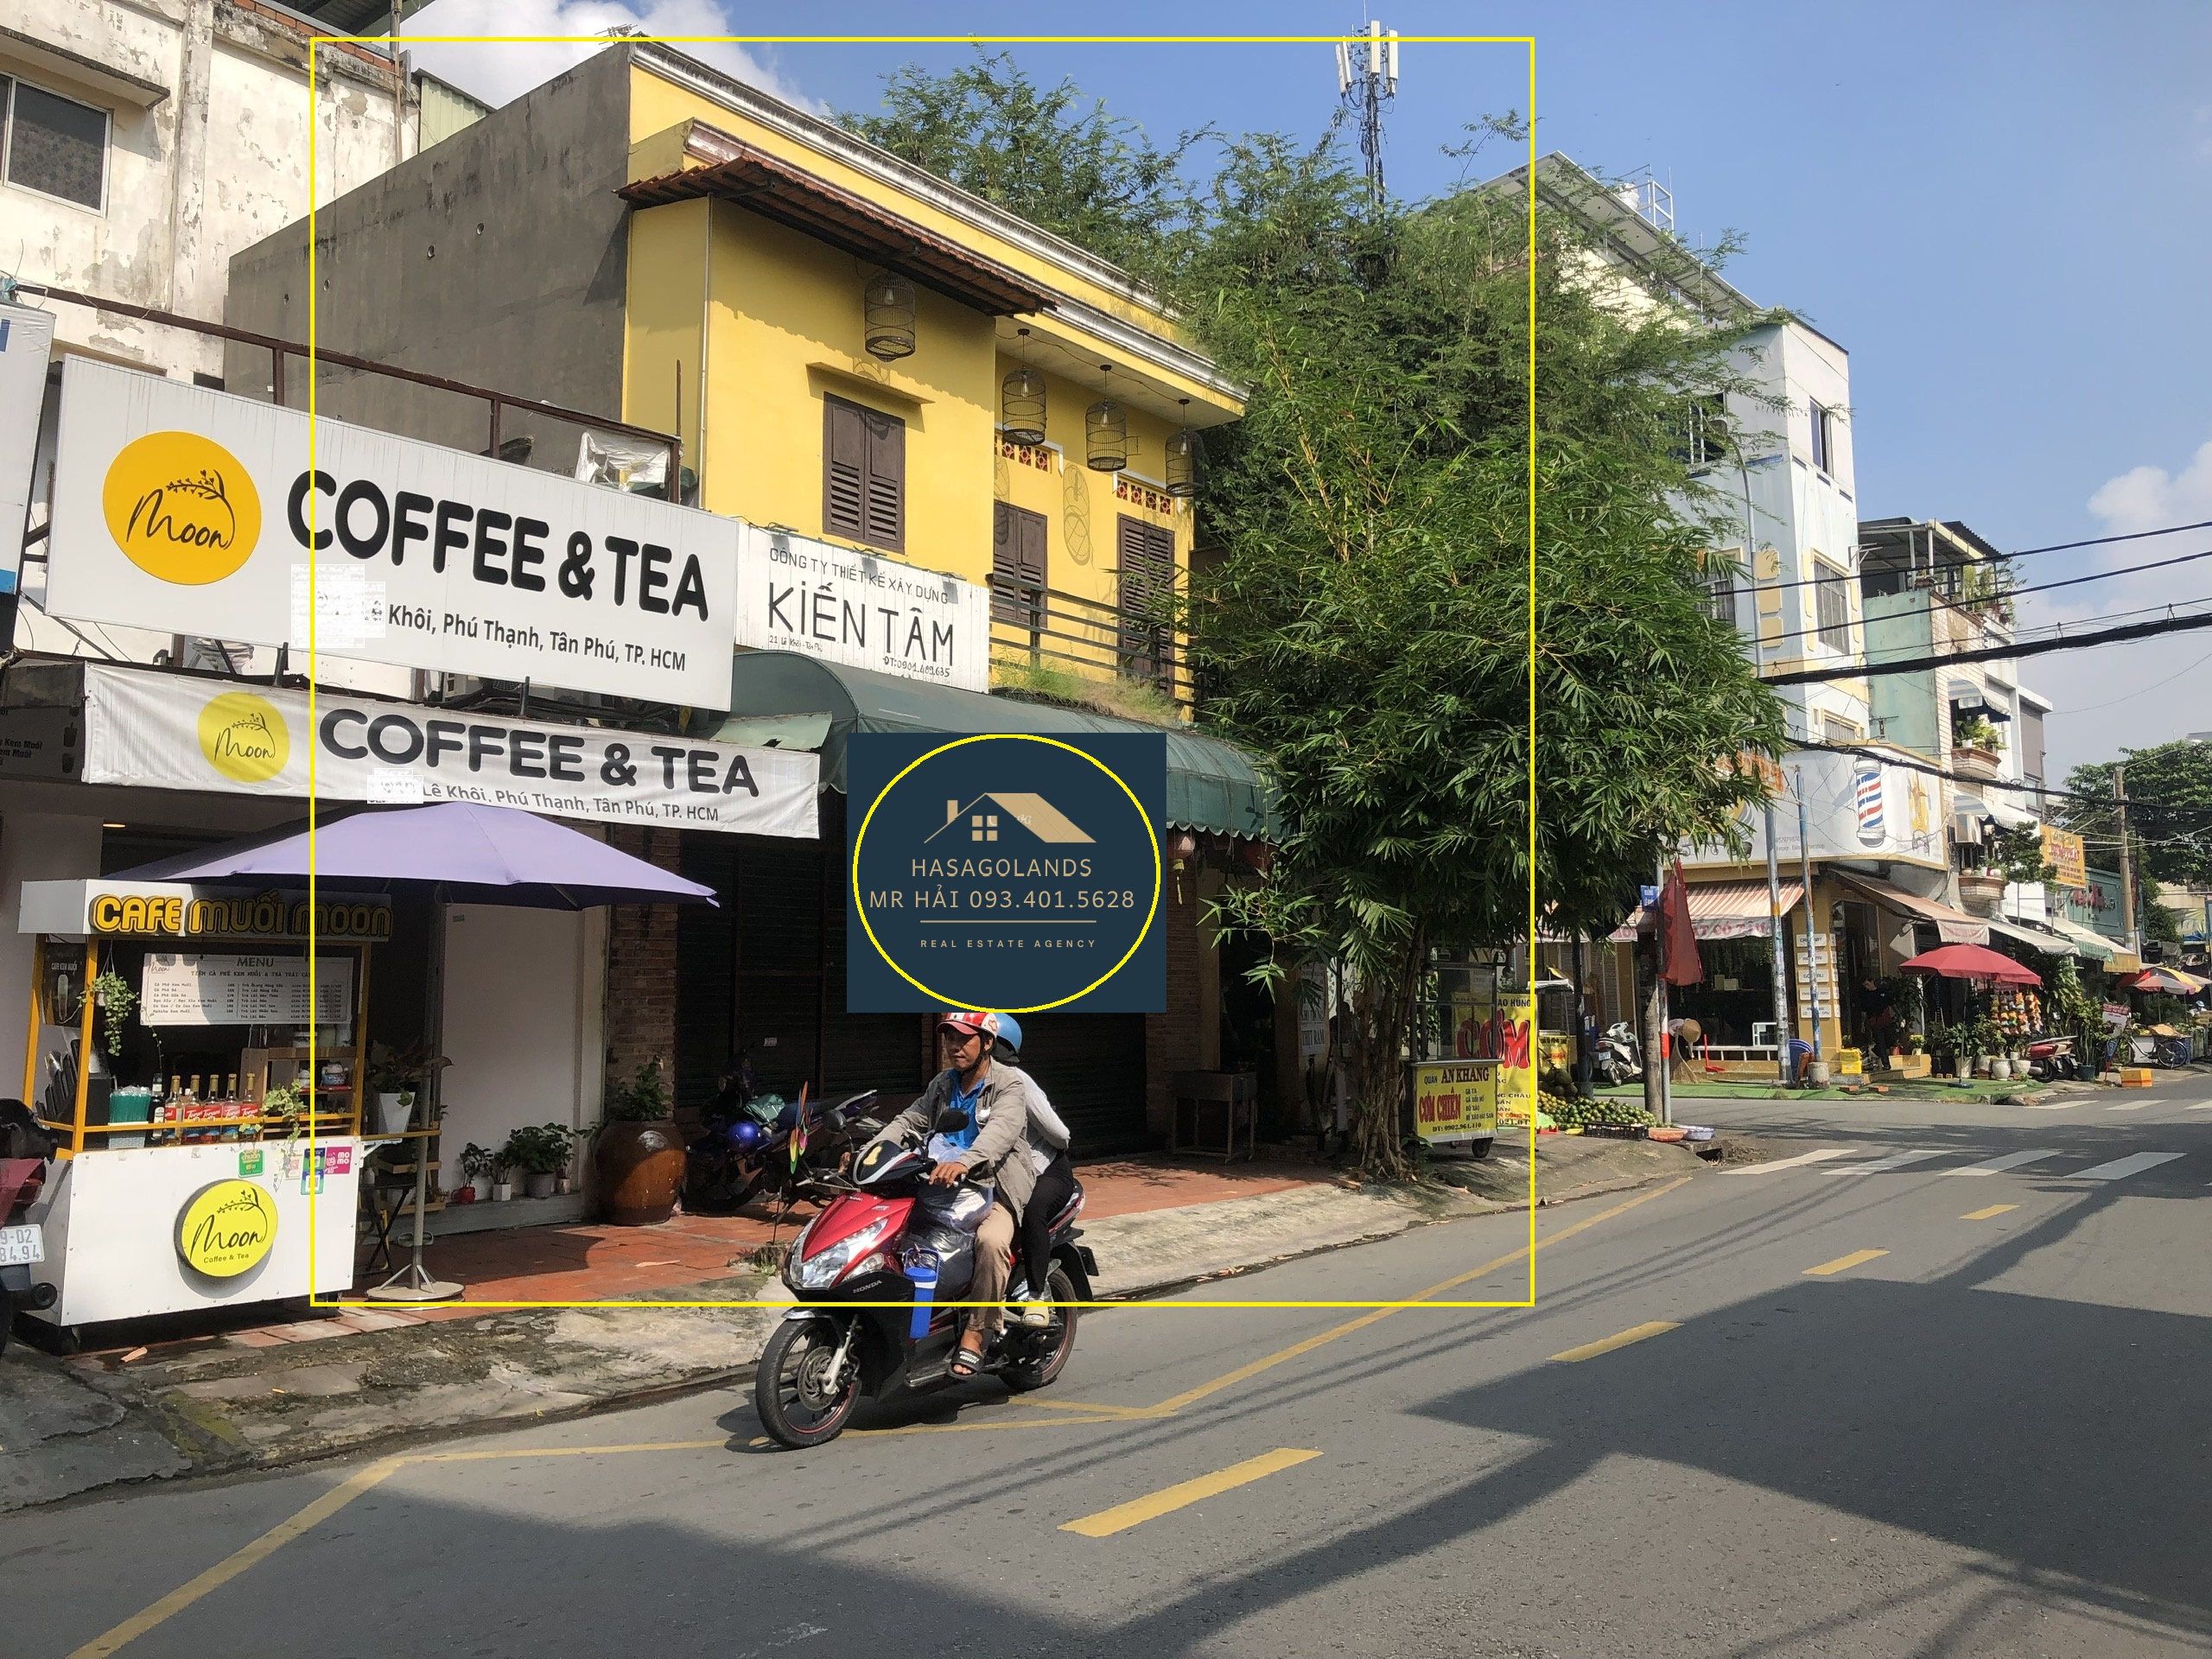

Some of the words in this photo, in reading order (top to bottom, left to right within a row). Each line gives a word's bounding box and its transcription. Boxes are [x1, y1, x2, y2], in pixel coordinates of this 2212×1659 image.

[126, 488, 235, 550] Moon
[288, 470, 550, 592] COFFEE
[557, 531, 595, 601] &
[605, 535, 709, 622] TEA
[769, 547, 807, 569] CÔNG
[810, 558, 828, 575] TY
[888, 577, 912, 594] XÂY
[916, 585, 948, 604] DỰNG
[388, 604, 436, 634] Khôi,
[442, 611, 479, 639] Phú
[484, 619, 543, 652] Thạnh,
[550, 631, 579, 654] Tân
[584, 636, 620, 663] Phú,
[624, 644, 645, 664] TP.
[651, 648, 686, 671] HCM
[769, 581, 866, 648] KIẾN
[877, 607, 953, 666] TÂM
[769, 635, 778, 644] 21
[214, 727, 276, 761] Moon
[319, 709, 585, 782] COFFEE
[600, 742, 638, 786] &
[651, 746, 760, 798] TEA
[495, 790, 529, 806] Phú
[532, 792, 589, 814] Thạnh,
[593, 798, 621, 815] Tân
[625, 800, 659, 818] Phú,
[662, 804, 683, 818] TP.
[687, 806, 719, 822] HCM
[93, 895, 183, 932] CAFE
[237, 957, 274, 967] MENU
[1441, 1068, 1455, 1084] AN
[1456, 1067, 1490, 1083] KHANG
[190, 1214, 267, 1261] Moon
[204, 1255, 226, 1264] Coffee
[853, 1280, 882, 1294] HONDA
